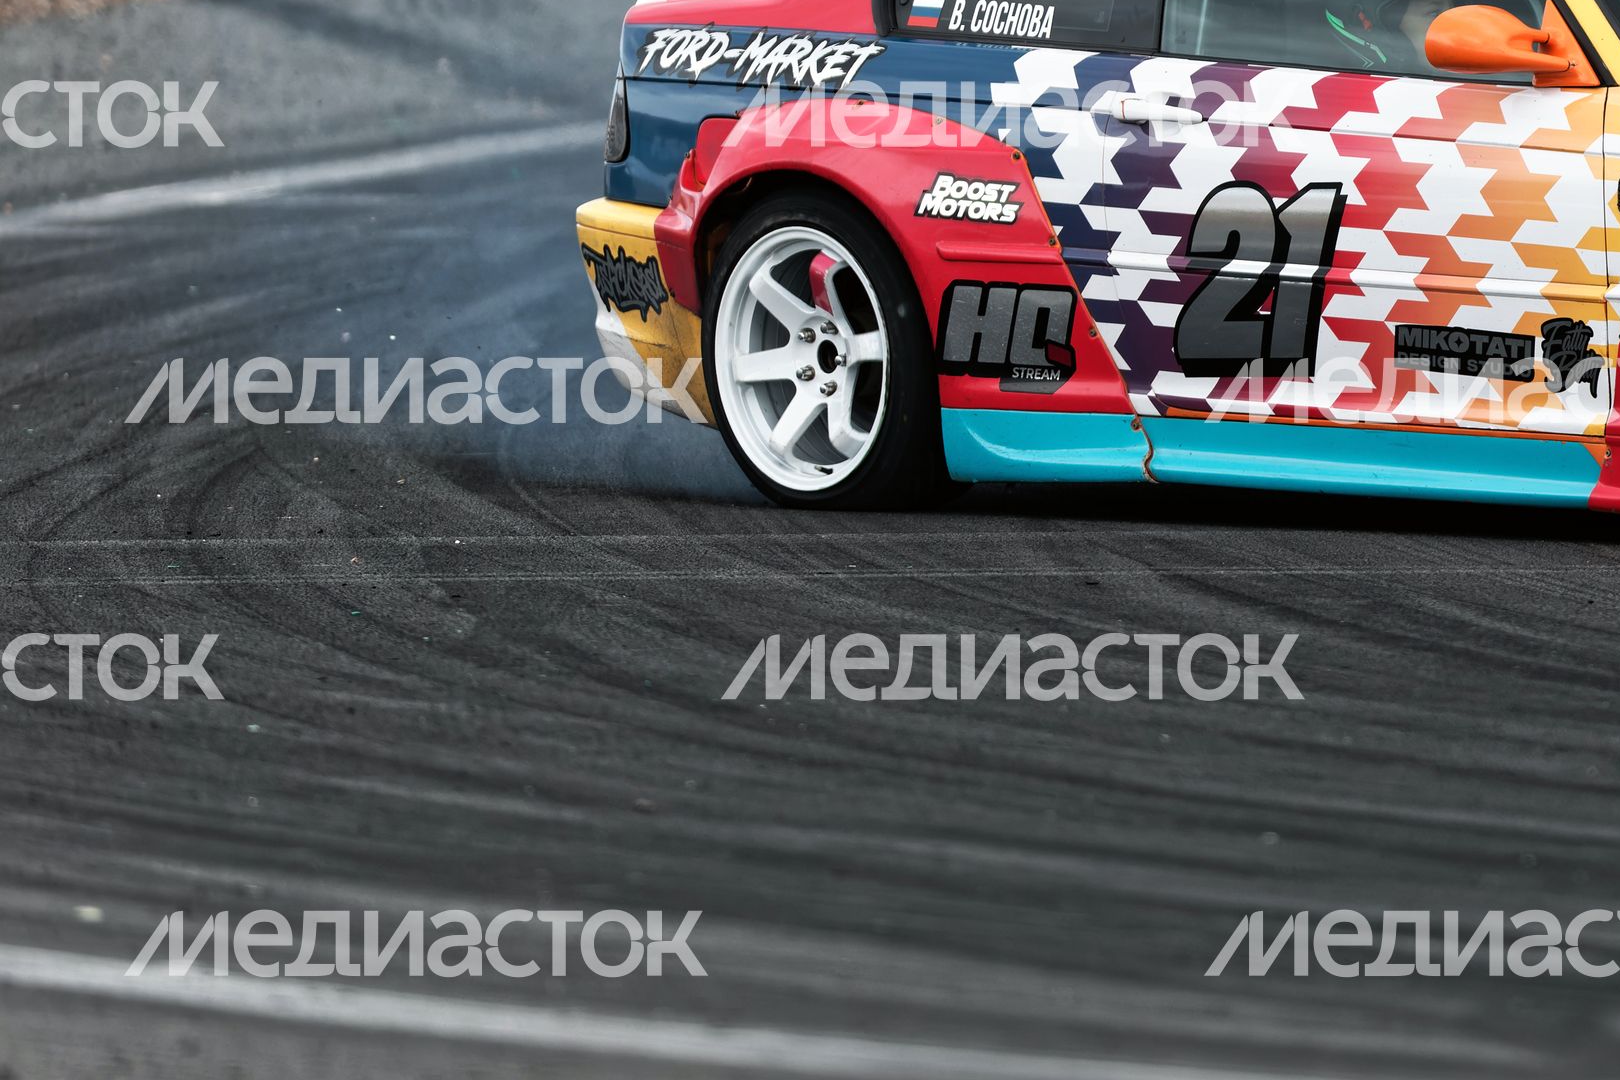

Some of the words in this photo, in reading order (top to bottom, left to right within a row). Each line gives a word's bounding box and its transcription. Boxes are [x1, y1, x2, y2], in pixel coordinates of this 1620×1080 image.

[970, 0, 1055, 39] СОСНОВА
[639, 27, 886, 88] FORD-MARKET
[931, 174, 1017, 203] BOOST
[917, 193, 1020, 223] MOTORS
[1176, 183, 1345, 366] 21
[943, 285, 1075, 368] HQ
[1398, 326, 1532, 358] MIKOTATI
[1012, 367, 1061, 380] STREAM
[1398, 351, 1461, 371] DESIGN
[1467, 359, 1532, 378] STUDIO
